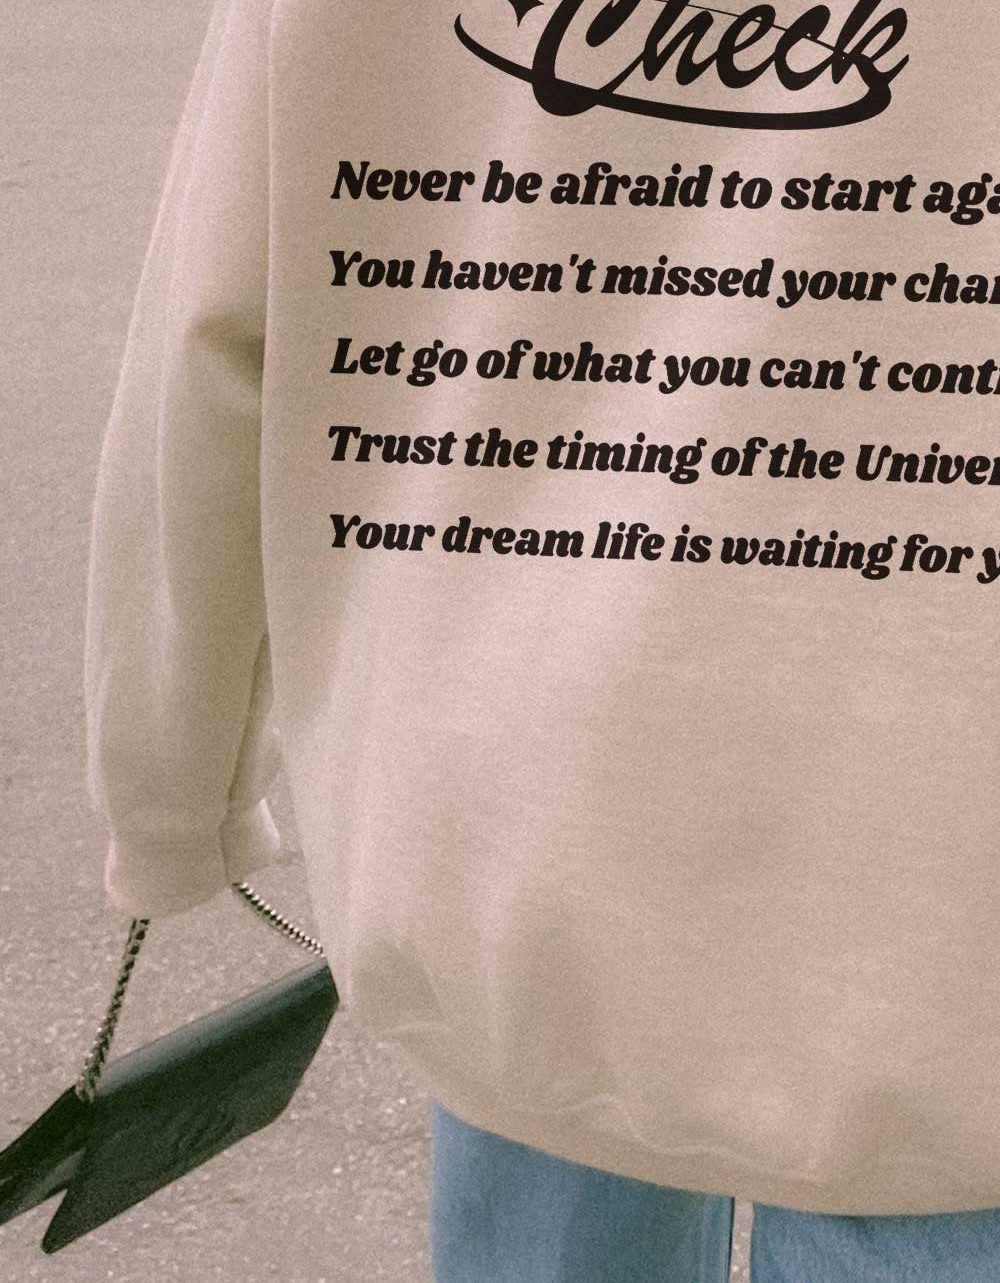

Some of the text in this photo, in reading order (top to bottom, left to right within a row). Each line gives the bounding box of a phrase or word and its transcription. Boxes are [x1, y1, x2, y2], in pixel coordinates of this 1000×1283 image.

[330, 160, 476, 202] Never
[481, 159, 543, 204] be
[550, 161, 714, 208] afraid
[720, 170, 773, 210] to
[780, 172, 917, 213] start
[329, 250, 416, 289] You
[421, 249, 597, 294] haven't
[600, 254, 775, 298] missed
[776, 269, 897, 309] your
[329, 337, 406, 376] Let
[406, 339, 468, 387] go
[476, 339, 534, 380] of
[532, 341, 657, 384] what
[658, 355, 751, 395] you
[759, 350, 881, 392] can't
[328, 425, 458, 466] Trust
[464, 427, 539, 469] the
[546, 430, 708, 485] timing
[711, 436, 769, 477] of
[767, 438, 845, 480] the
[329, 514, 436, 551] Your
[441, 515, 585, 558] dream
[591, 521, 665, 561] life
[670, 524, 713, 563] is
[720, 528, 898, 581] waiting
[899, 533, 974, 574] for
